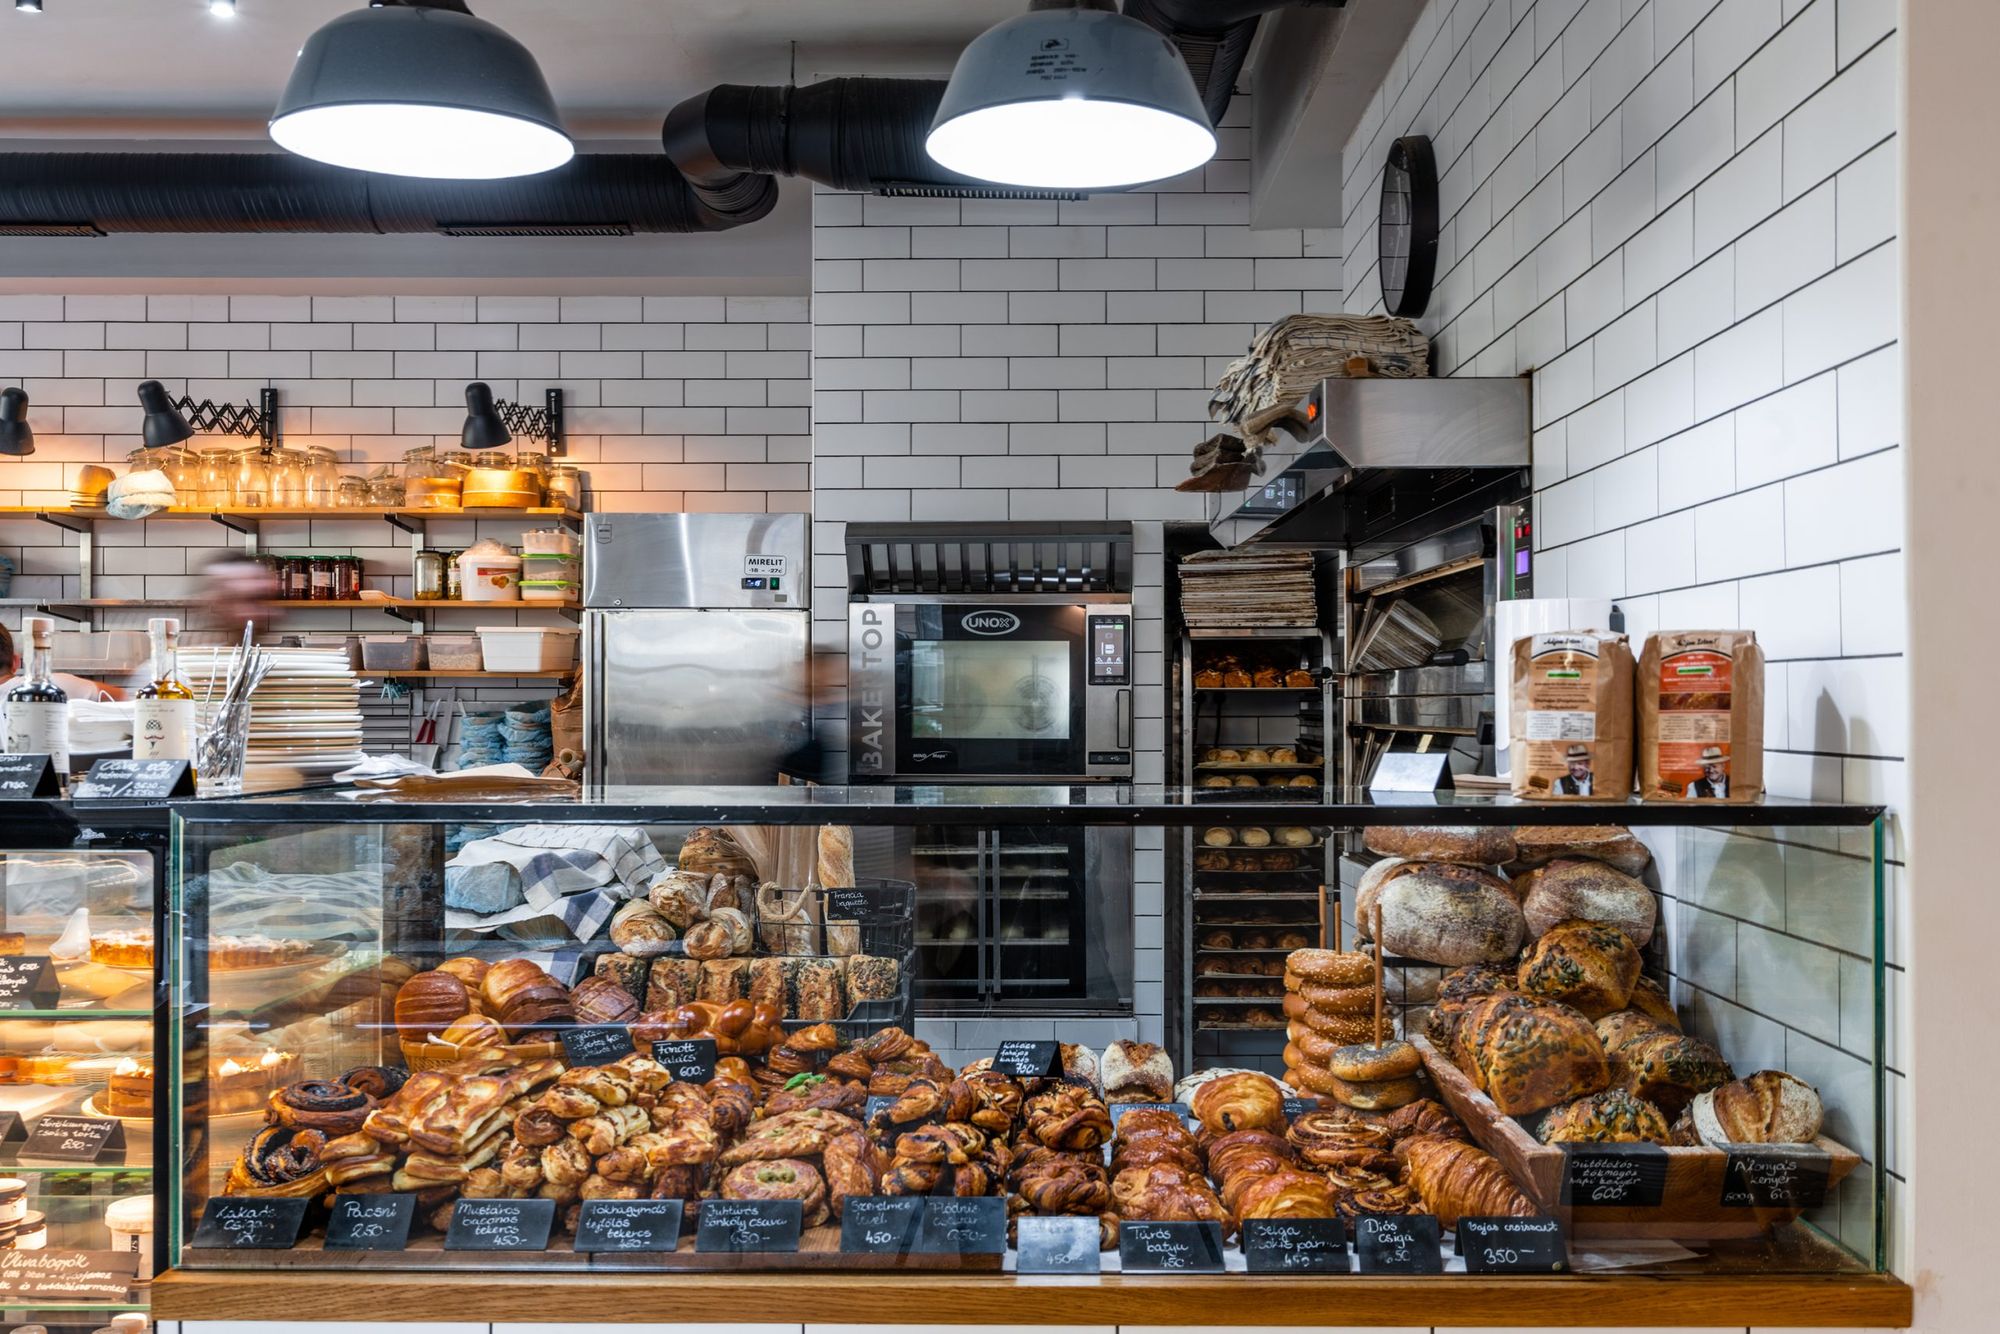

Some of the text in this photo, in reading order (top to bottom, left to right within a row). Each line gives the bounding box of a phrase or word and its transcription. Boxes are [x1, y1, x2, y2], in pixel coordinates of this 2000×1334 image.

[748, 558, 784, 566] MIRELIT
[967, 617, 1011, 628] UNOX
[343, 1200, 397, 1218] Pacsni
[474, 1225, 519, 1236] tekercs
[1364, 1218, 1398, 1234] Diós
[606, 1228, 653, 1239] tekercs
